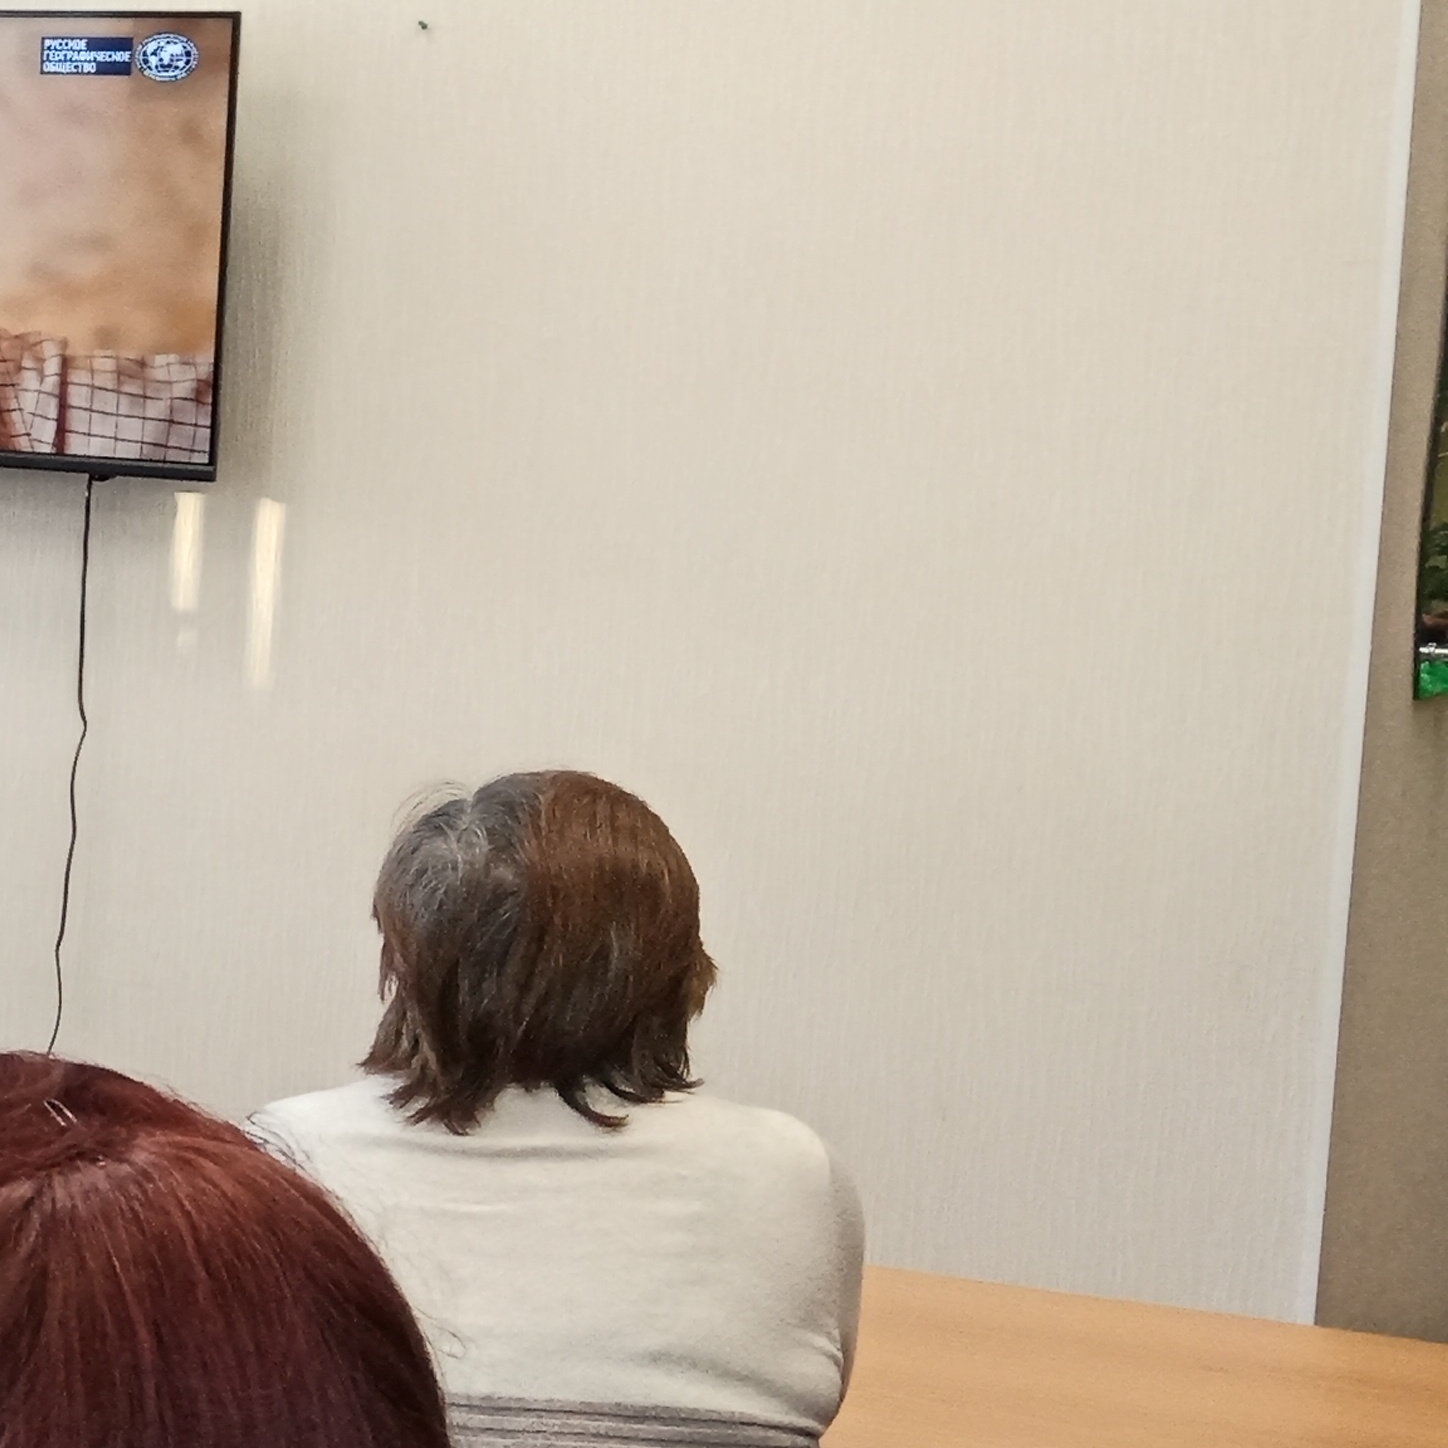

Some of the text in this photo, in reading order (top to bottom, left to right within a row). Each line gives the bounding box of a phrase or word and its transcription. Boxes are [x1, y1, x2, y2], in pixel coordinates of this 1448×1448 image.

[43, 38, 88, 50] РУССКОЕ
[43, 50, 132, 62] ГЕОГРАФИЧЕСКОЕ
[42, 62, 97, 74] ОБЩЕСТВО
